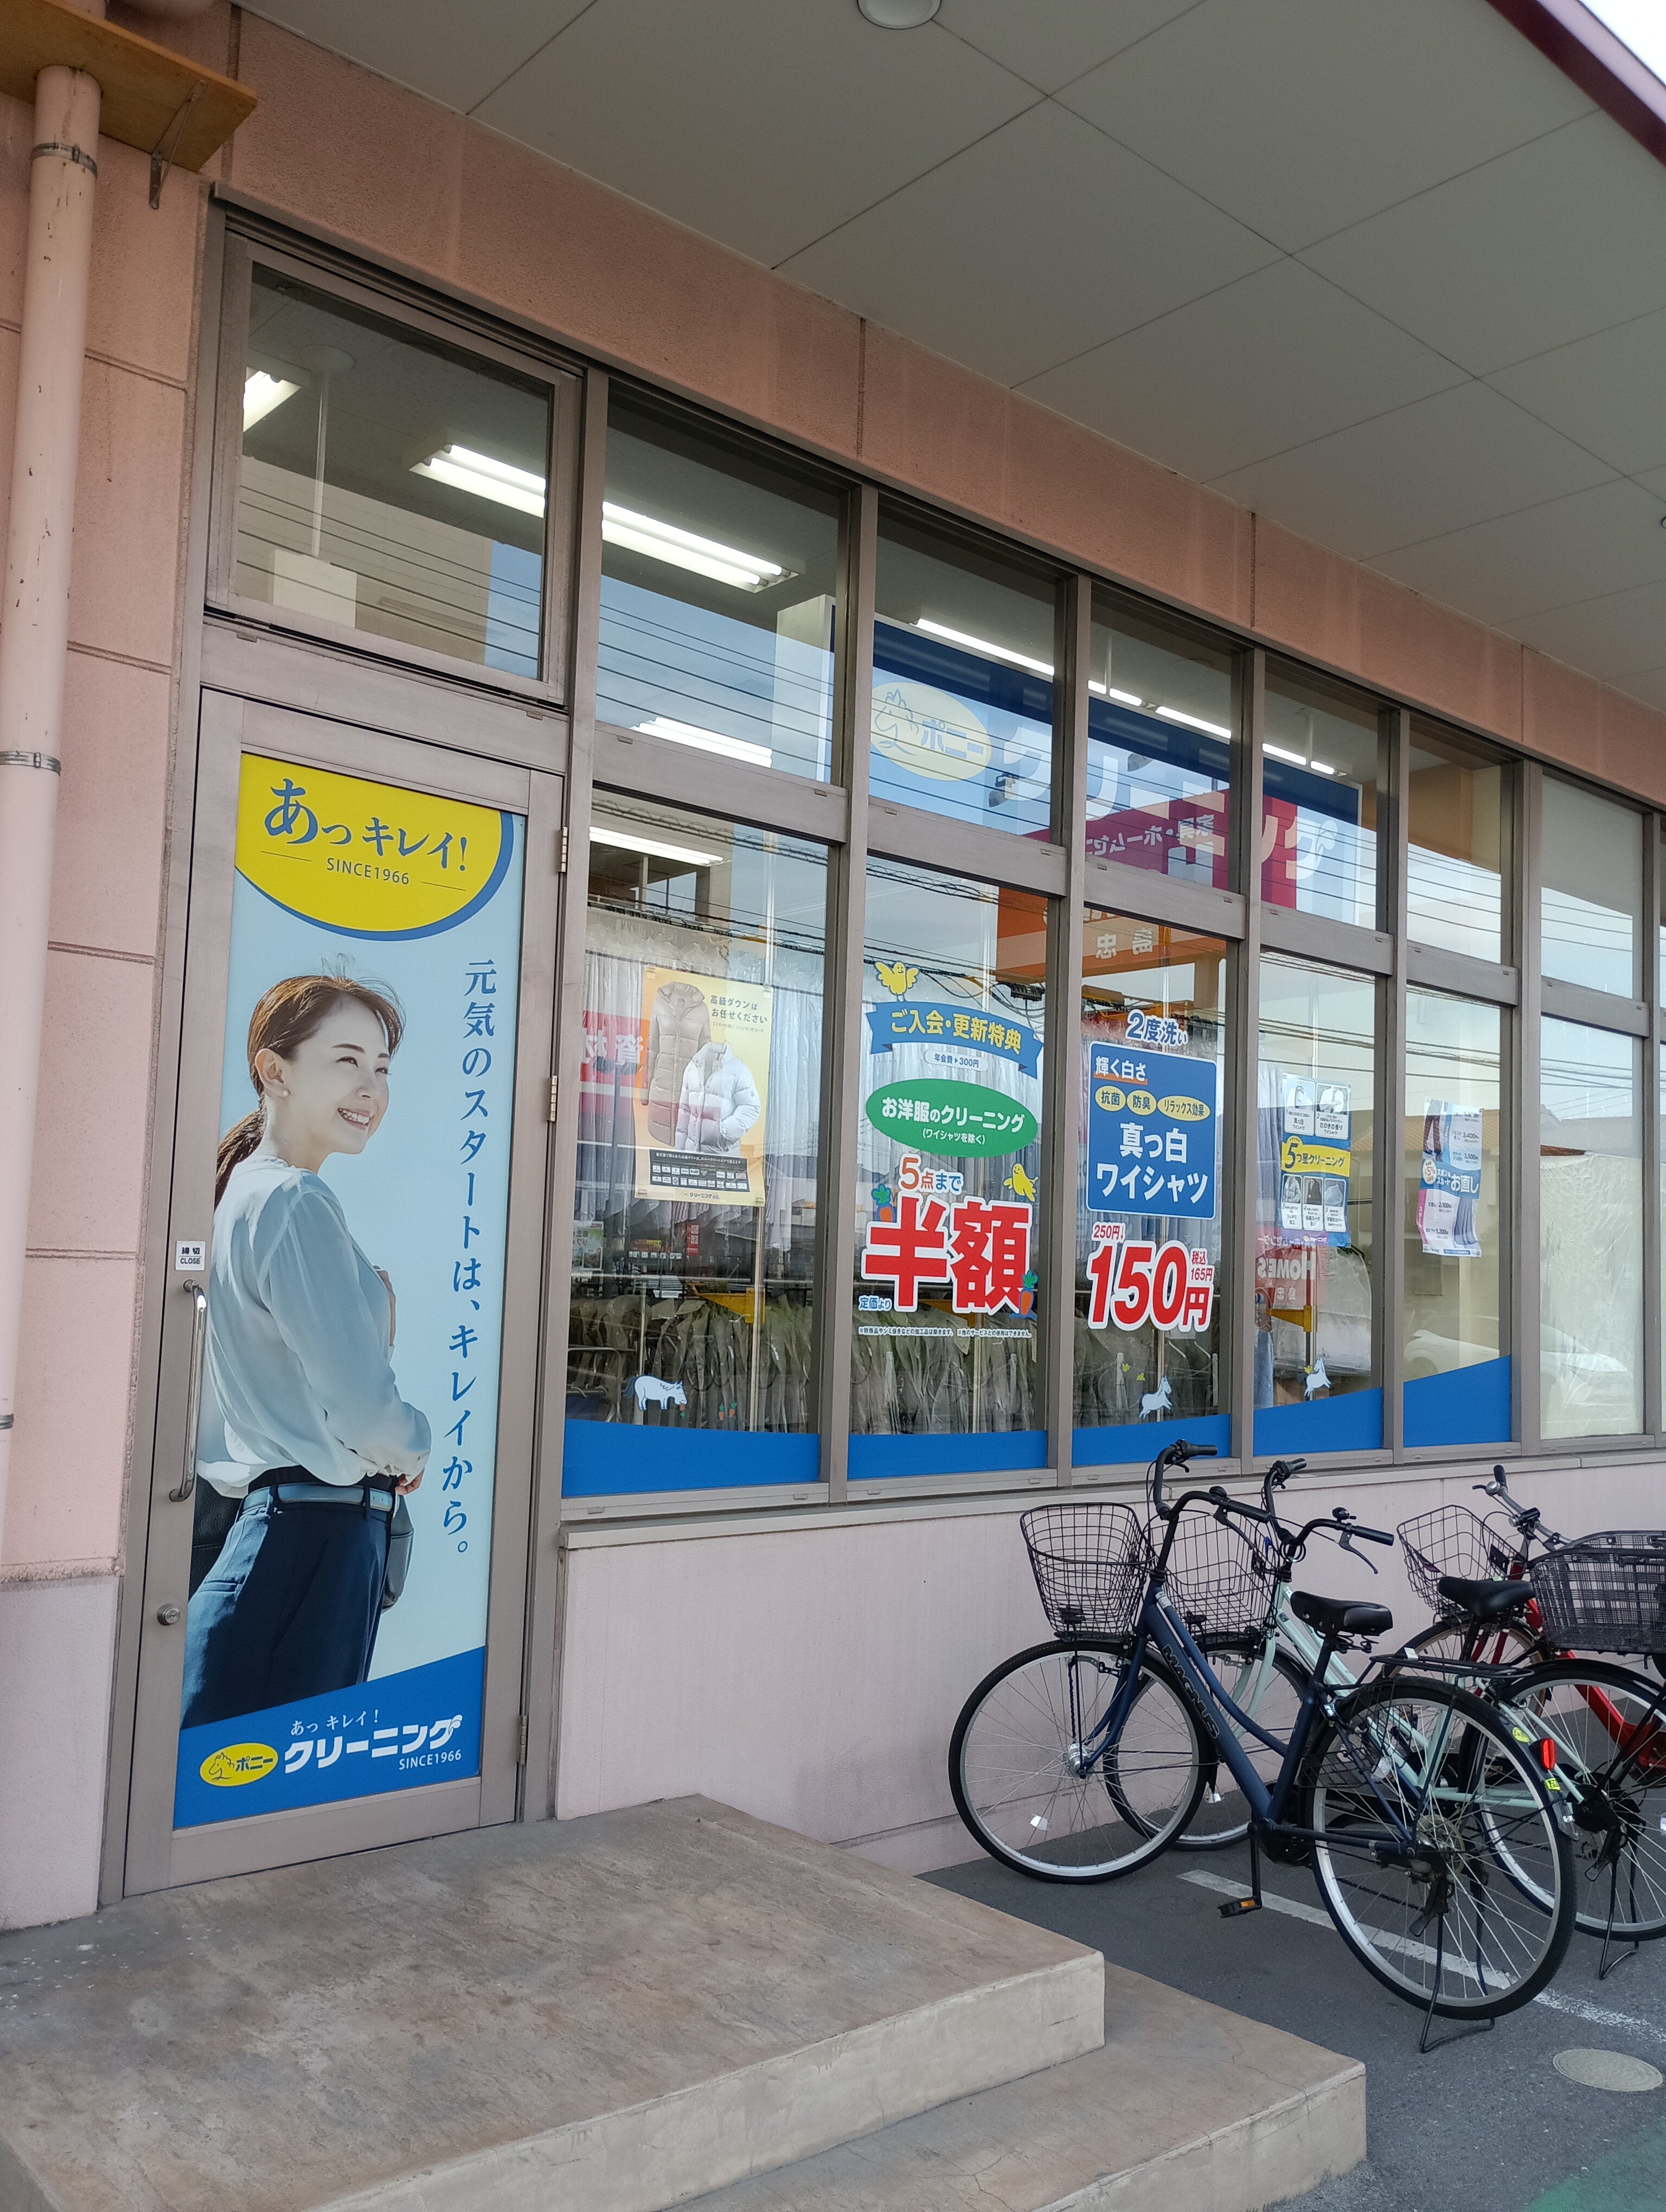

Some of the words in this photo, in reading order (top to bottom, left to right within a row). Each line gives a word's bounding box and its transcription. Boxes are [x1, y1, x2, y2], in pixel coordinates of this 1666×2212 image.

[326, 858, 410, 885] SINCE1966
[711, 995, 758, 1011] 高級ダウンは
[712, 1008, 768, 1024] お任せください
[892, 1008, 1022, 1054] ご入会・更新特典
[1126, 1012, 1188, 1045] 2度洗い
[959, 1058, 979, 1068] 300円
[1095, 1056, 1146, 1082] 輝く白さ
[881, 1097, 1026, 1133] お洋服のクリーニング
[1101, 1090, 1120, 1106] 抗菌
[1132, 1095, 1151, 1110] 防臭
[1164, 1099, 1204, 1117] リラックス効果
[922, 1128, 986, 1145] (ワイシャツを除く)
[1119, 1122, 1188, 1164] 真っ白
[1285, 1142, 1346, 1169] 5つ星クリーニング
[900, 1157, 962, 1192] 5点まで
[1097, 1162, 1208, 1204] ワイシャツ
[1451, 1173, 1479, 1194] お直し
[1093, 1224, 1120, 1240] 250円
[865, 1196, 1029, 1310] 半額
[1191, 1251, 1206, 1265] 税込
[1091, 1245, 1210, 1326] 150円
[1190, 1268, 1213, 1282] 165円
[860, 1297, 892, 1310] 定価より
[1162, 1644, 1220, 1739] MAGNUS
[285, 1714, 463, 1774] クリーニング
[235, 1756, 273, 1772] ポニー
[399, 1750, 462, 1771] SINCE1966
